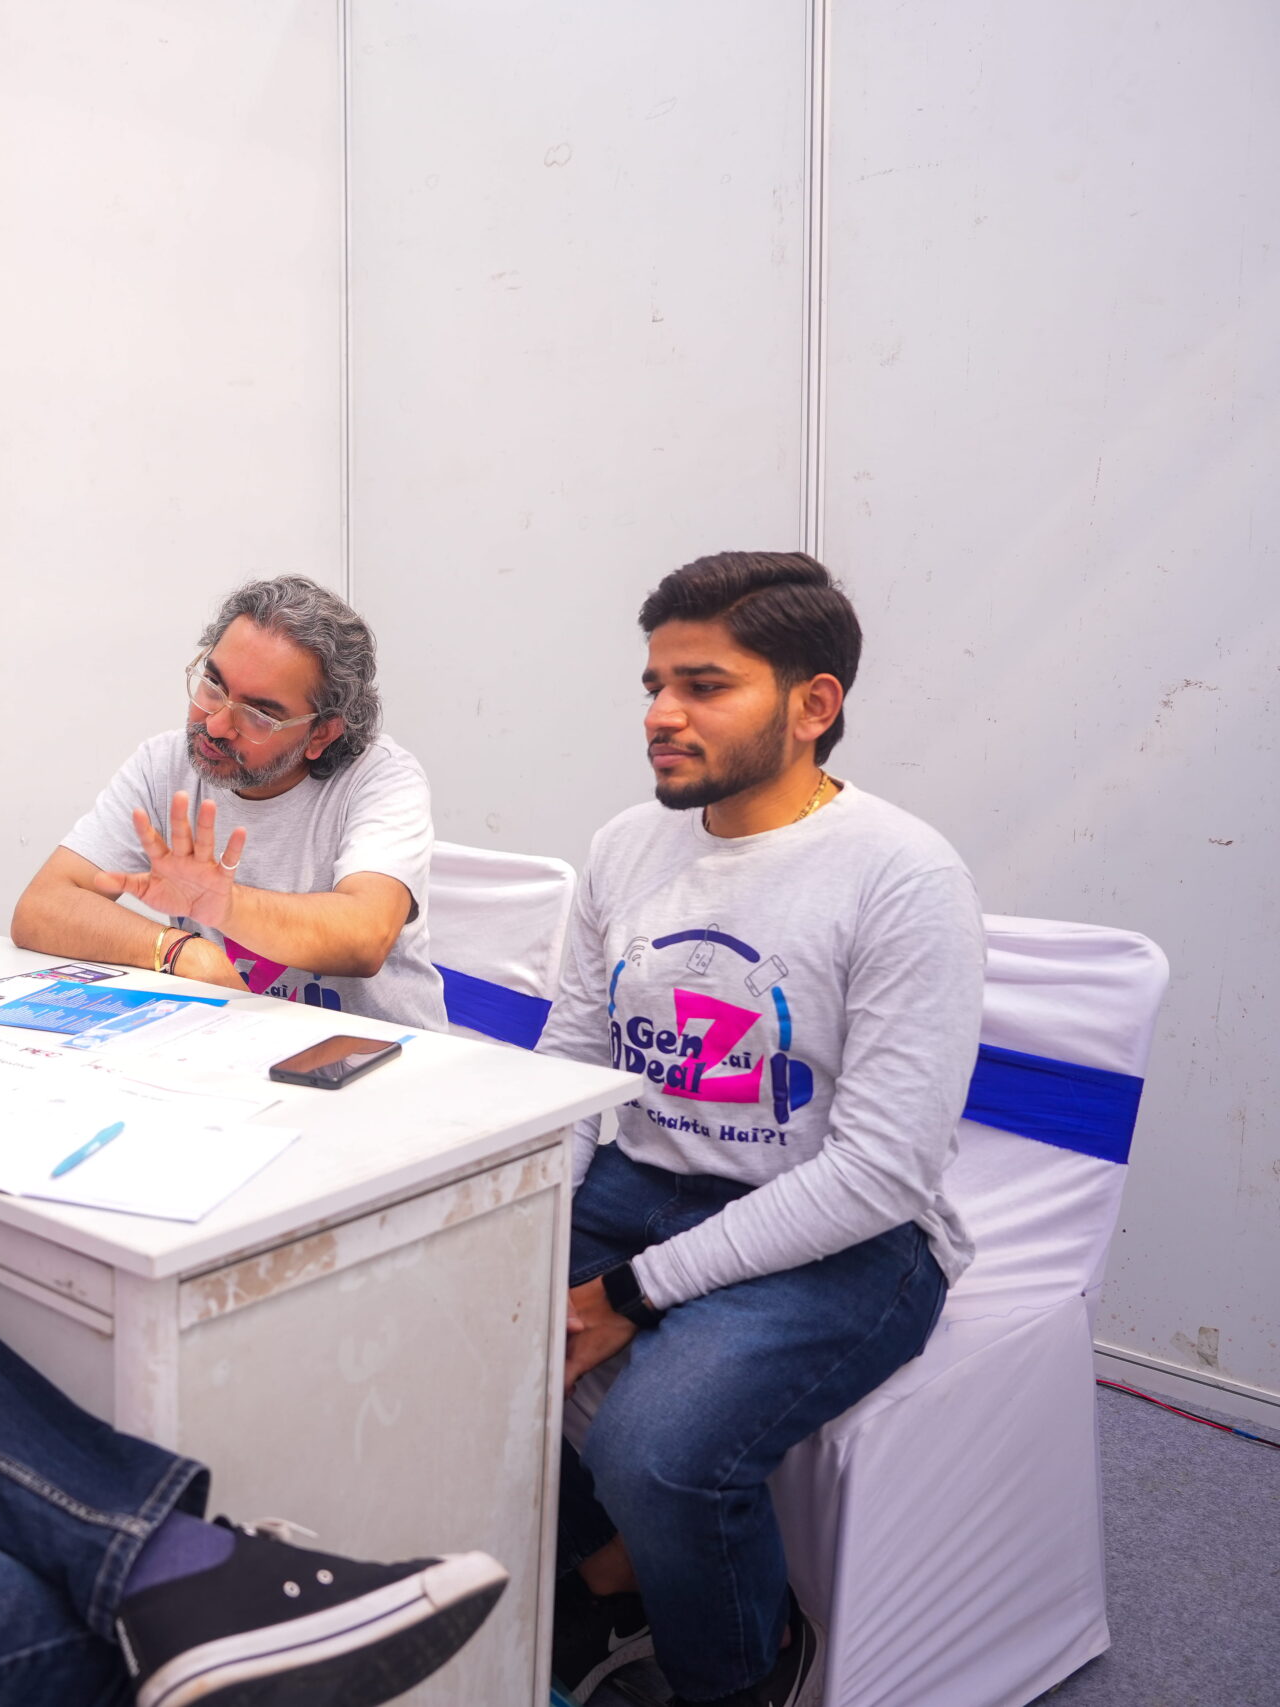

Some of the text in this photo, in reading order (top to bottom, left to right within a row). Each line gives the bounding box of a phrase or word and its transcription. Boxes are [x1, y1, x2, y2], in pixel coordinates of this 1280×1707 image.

[626, 1016, 703, 1060] Gen
[662, 988, 763, 1103] Z
[623, 1043, 706, 1094] Deal
[719, 1125, 788, 1146] Hai?!
